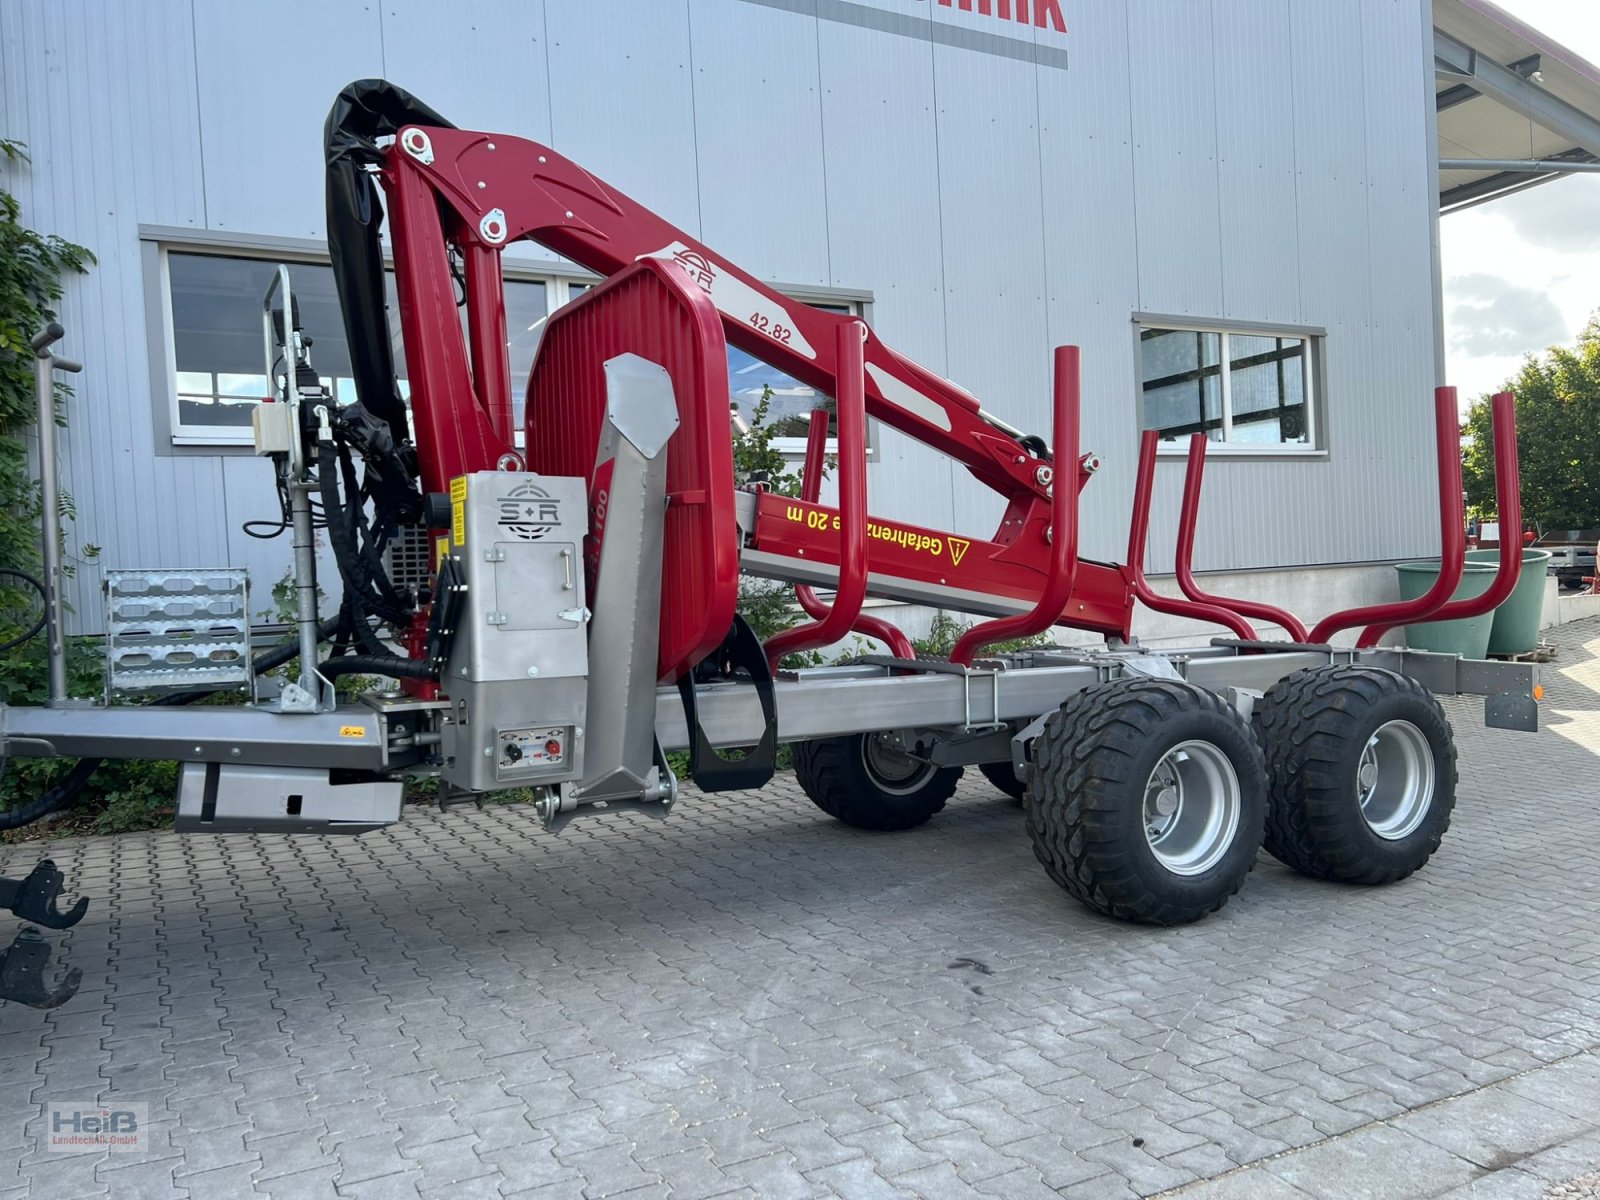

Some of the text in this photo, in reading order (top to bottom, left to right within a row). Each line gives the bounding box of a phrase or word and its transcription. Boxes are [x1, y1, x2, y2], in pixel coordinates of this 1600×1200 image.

[750, 312, 792, 344] 42.82
[786, 506, 803, 521] m
[808, 510, 829, 531] 20
